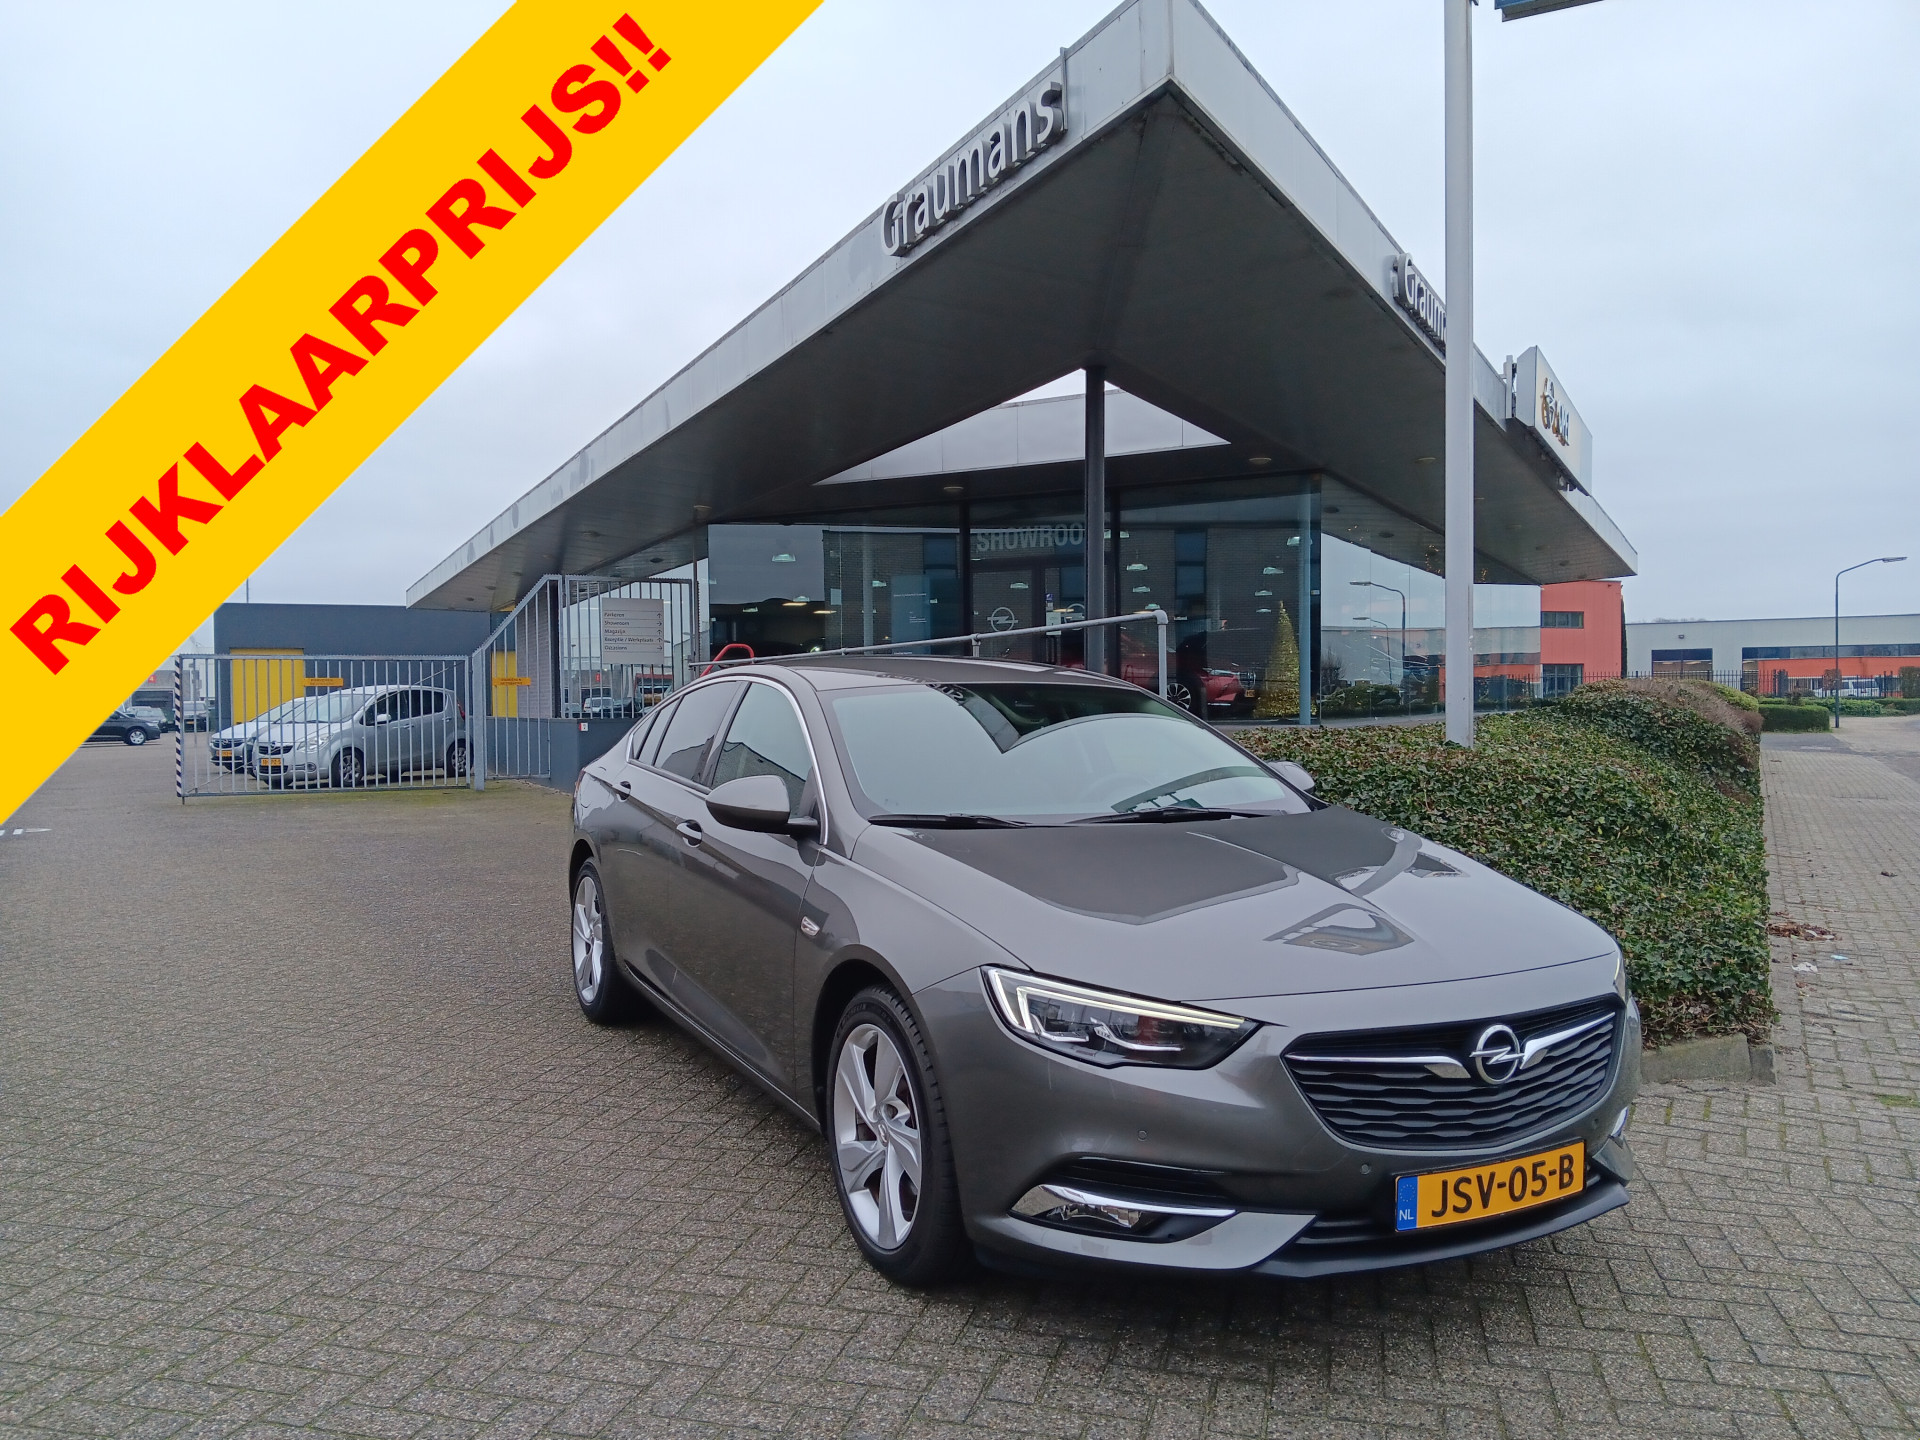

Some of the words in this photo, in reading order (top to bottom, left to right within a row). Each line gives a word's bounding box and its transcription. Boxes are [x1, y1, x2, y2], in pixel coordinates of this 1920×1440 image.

[881, 82, 1064, 256] Graumans
[976, 523, 1084, 552] SHOWROO
[1431, 1153, 1575, 1218] JSV-05-B
[1399, 1209, 1415, 1221] NL
